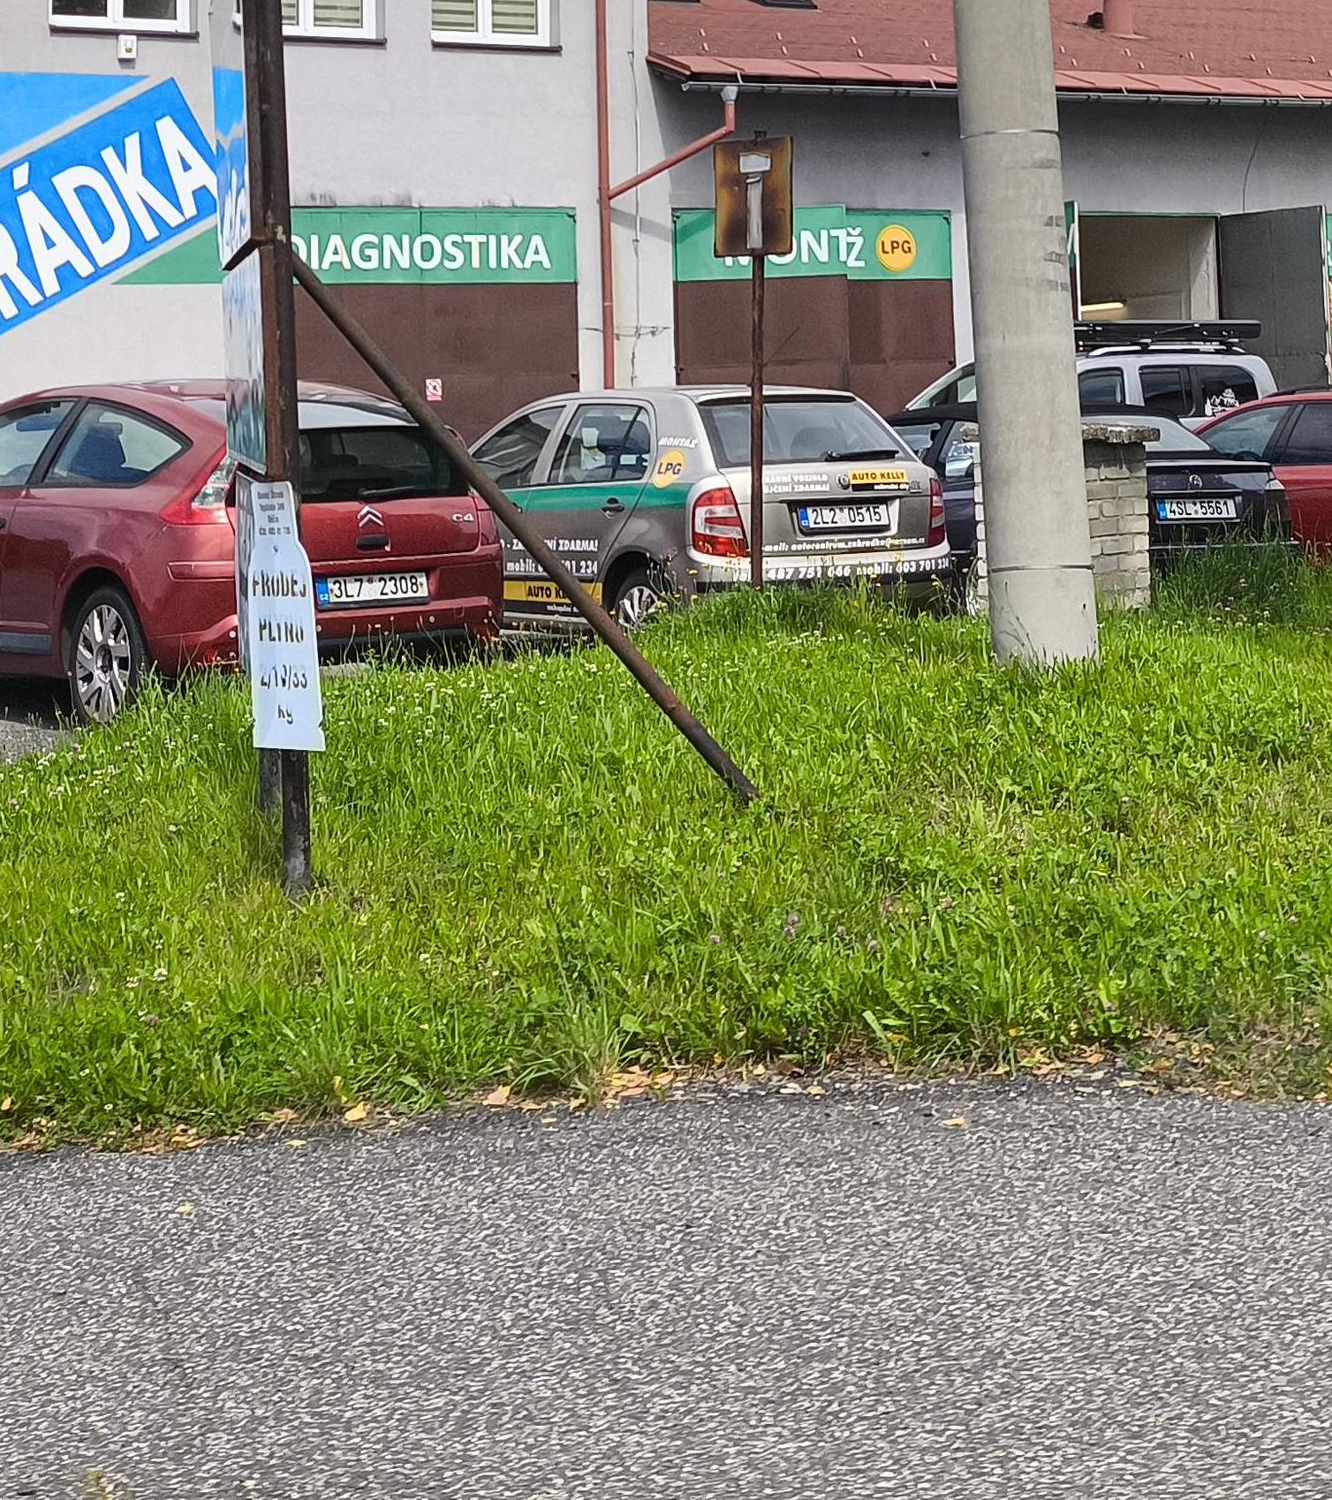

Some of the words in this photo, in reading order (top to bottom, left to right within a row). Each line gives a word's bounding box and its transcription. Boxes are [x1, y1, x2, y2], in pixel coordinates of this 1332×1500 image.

[291, 233, 552, 270] DIAGNOSTIKA
[880, 240, 913, 255] LPG
[657, 462, 682, 475] LPG
[852, 472, 878, 481] AUTO
[880, 471, 906, 480] KELLY
[812, 506, 839, 526] 2L2
[848, 504, 882, 524] 0515
[1169, 501, 1192, 516] 4SL
[1200, 500, 1231, 516] 5561
[452, 512, 475, 522] C4
[558, 538, 599, 552] ZDARMA!
[762, 541, 789, 553] -mail:
[332, 578, 364, 599] 3L7
[377, 575, 420, 596] 2308
[526, 585, 552, 599] AUTO
